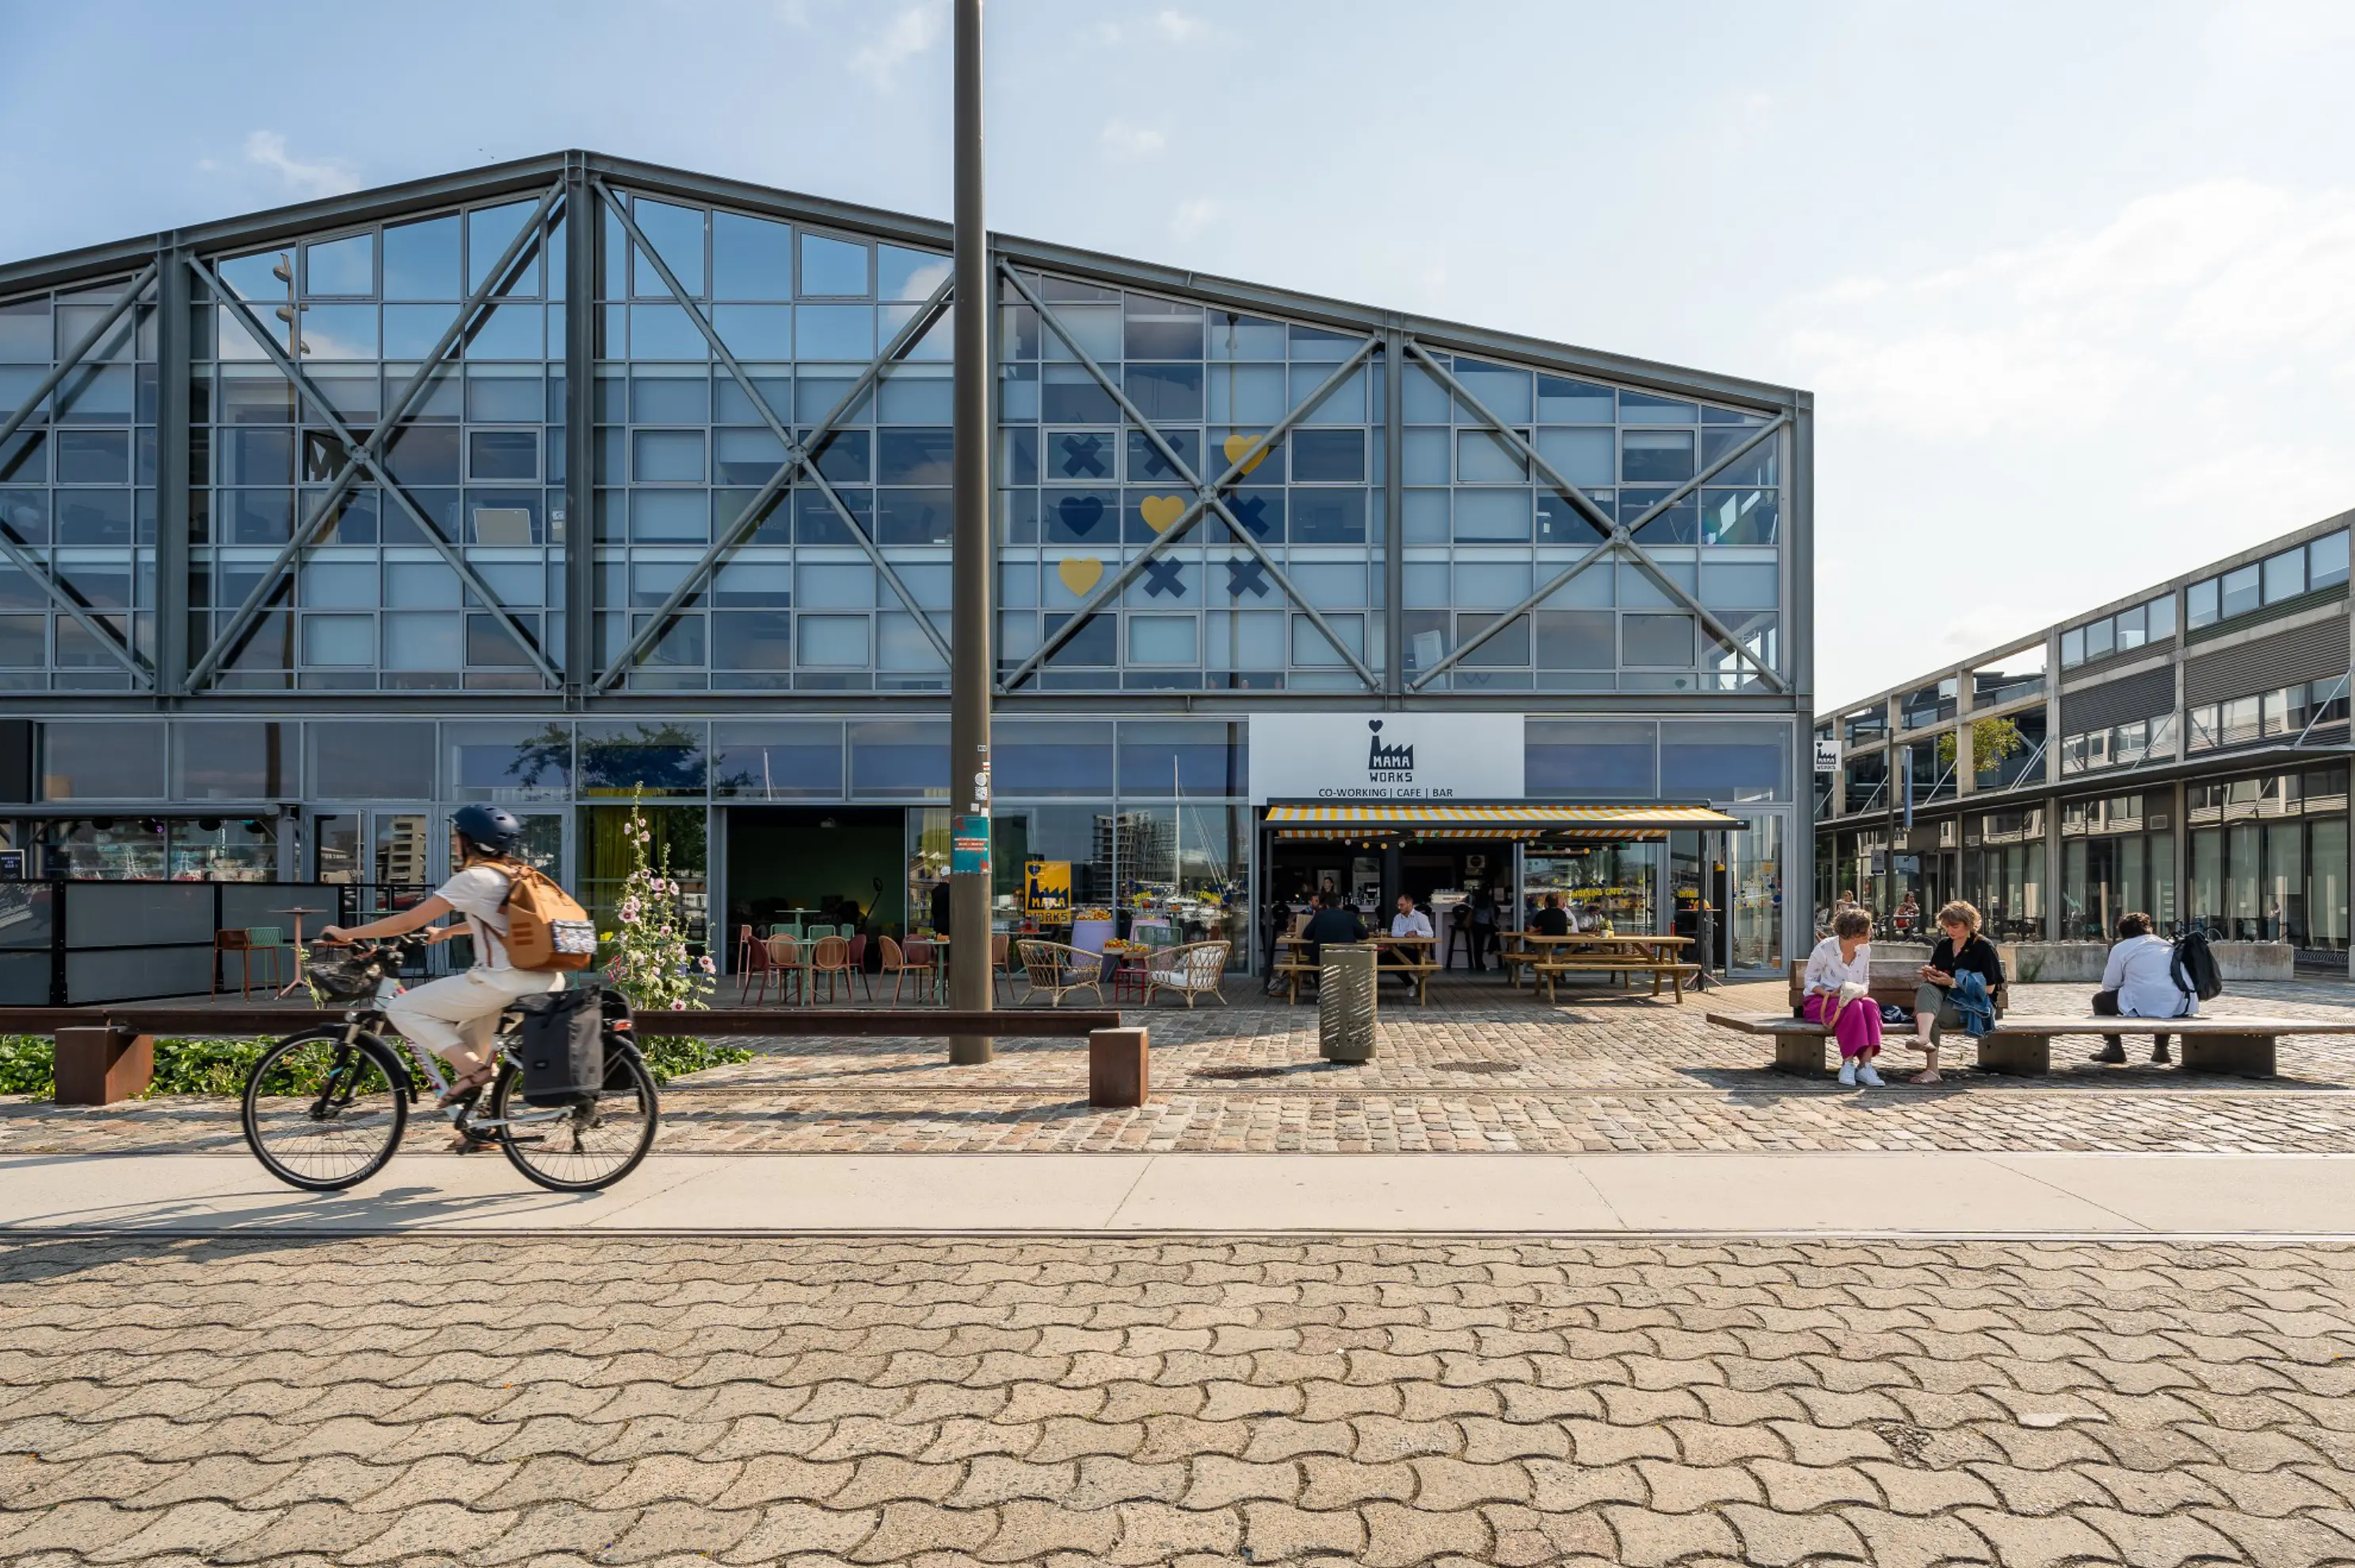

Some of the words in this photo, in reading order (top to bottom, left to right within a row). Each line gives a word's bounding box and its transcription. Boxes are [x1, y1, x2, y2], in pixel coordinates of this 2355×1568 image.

[1373, 755, 1410, 767] MAMA
[1370, 772, 1413, 782] WORKS
[1318, 788, 1387, 797] CO-WORKING
[1397, 788, 1422, 797] CAFE
[1432, 788, 1454, 797] BAR
[1031, 896, 1066, 908] MAMA
